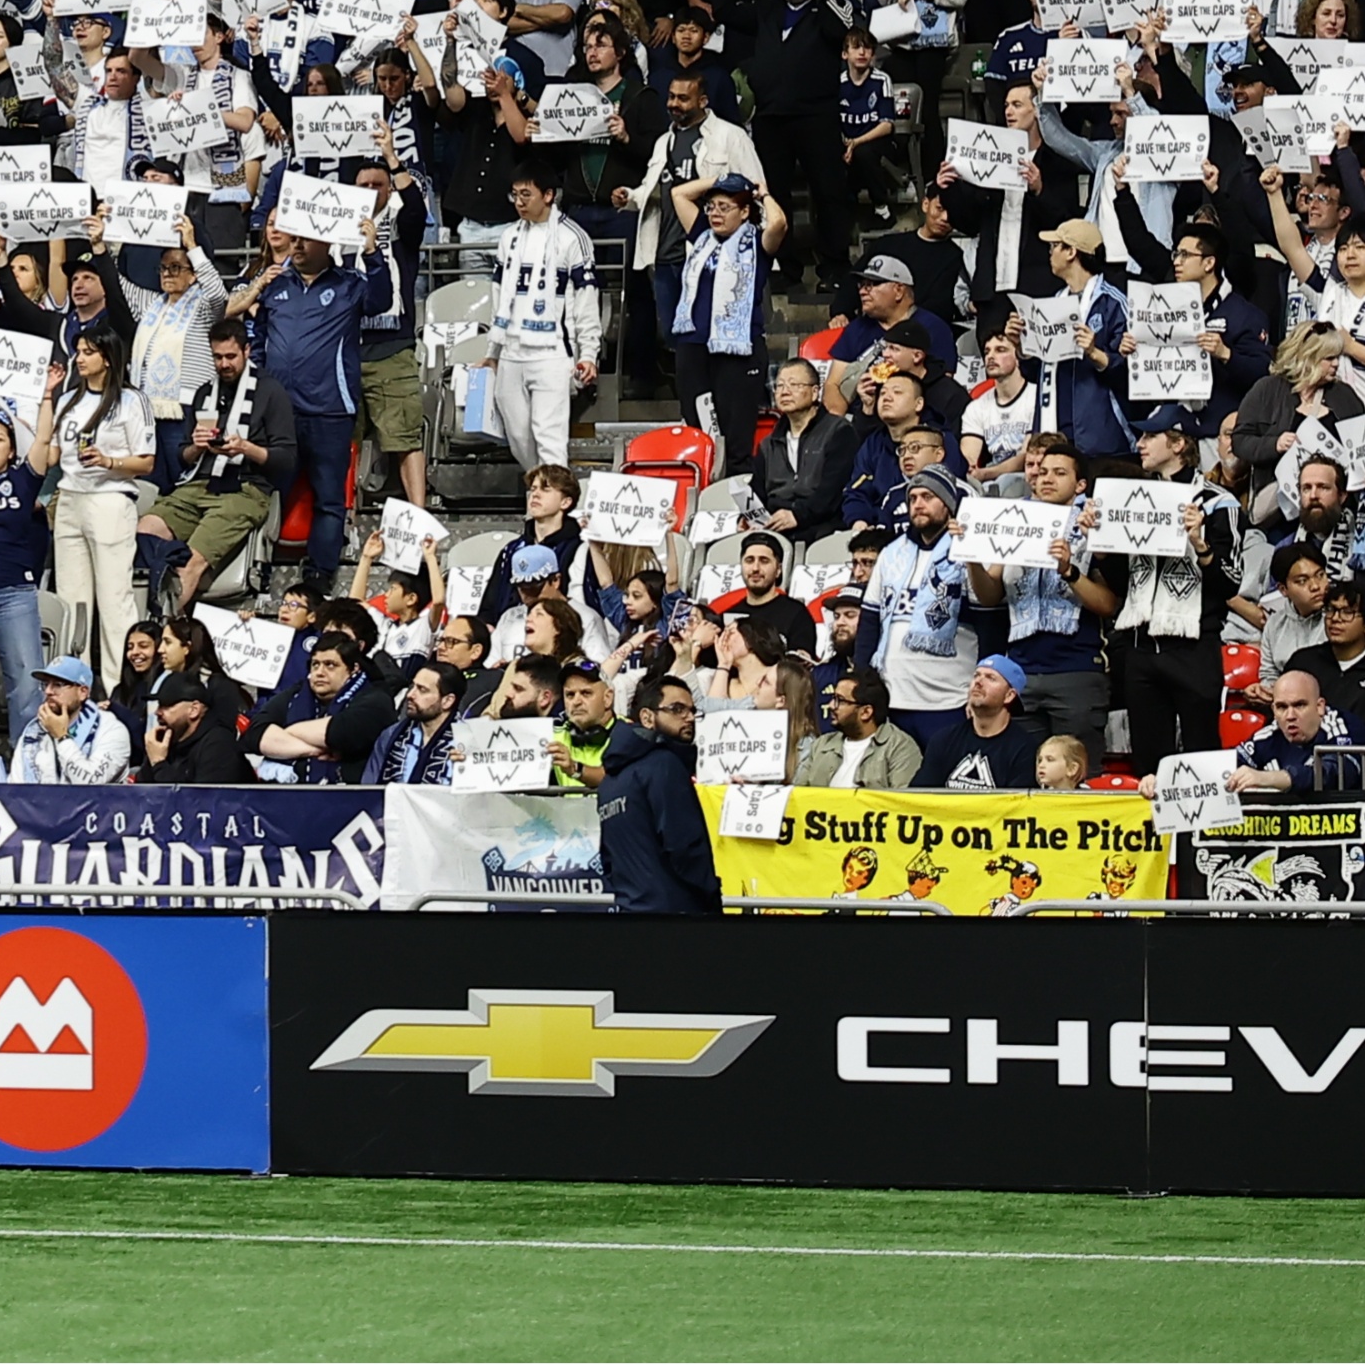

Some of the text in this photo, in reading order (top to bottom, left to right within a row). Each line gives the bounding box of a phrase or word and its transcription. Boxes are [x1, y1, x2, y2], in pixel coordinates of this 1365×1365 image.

[1009, 58, 1036, 73] TEL
[839, 111, 879, 124] TELUS
[309, 121, 367, 132] SAVE THE CAPS
[1135, 142, 1190, 154] SAVE THE CAPS
[12, 208, 74, 220] SAVE THE CAPS
[296, 200, 354, 219] SAVE THE CAPS
[6, 359, 31, 373] CAPS
[1144, 360, 1197, 372] SAVE THE CAPS
[599, 501, 654, 519] SAVE THE CAPS
[1108, 510, 1172, 526] SAVE THE CAPS
[974, 522, 1044, 539] SAVE THE CAPS
[473, 748, 535, 764] SAVE THE CAPS
[708, 743, 725, 756] SAVE
[739, 740, 766, 753] CAPS
[1162, 782, 1218, 801] SAVE THE CAPS
[746, 790, 763, 817] CAPS
[85, 810, 265, 840] COASTAL
[804, 810, 889, 843] Stuff
[896, 814, 943, 852] Up
[951, 824, 993, 850] on
[1003, 817, 1067, 851] The
[1077, 819, 1163, 852] Pitch
[1288, 813, 1356, 835] DREAMS
[491, 874, 604, 895] VANCOUVER
[837, 1016, 1365, 1093] CHEV
